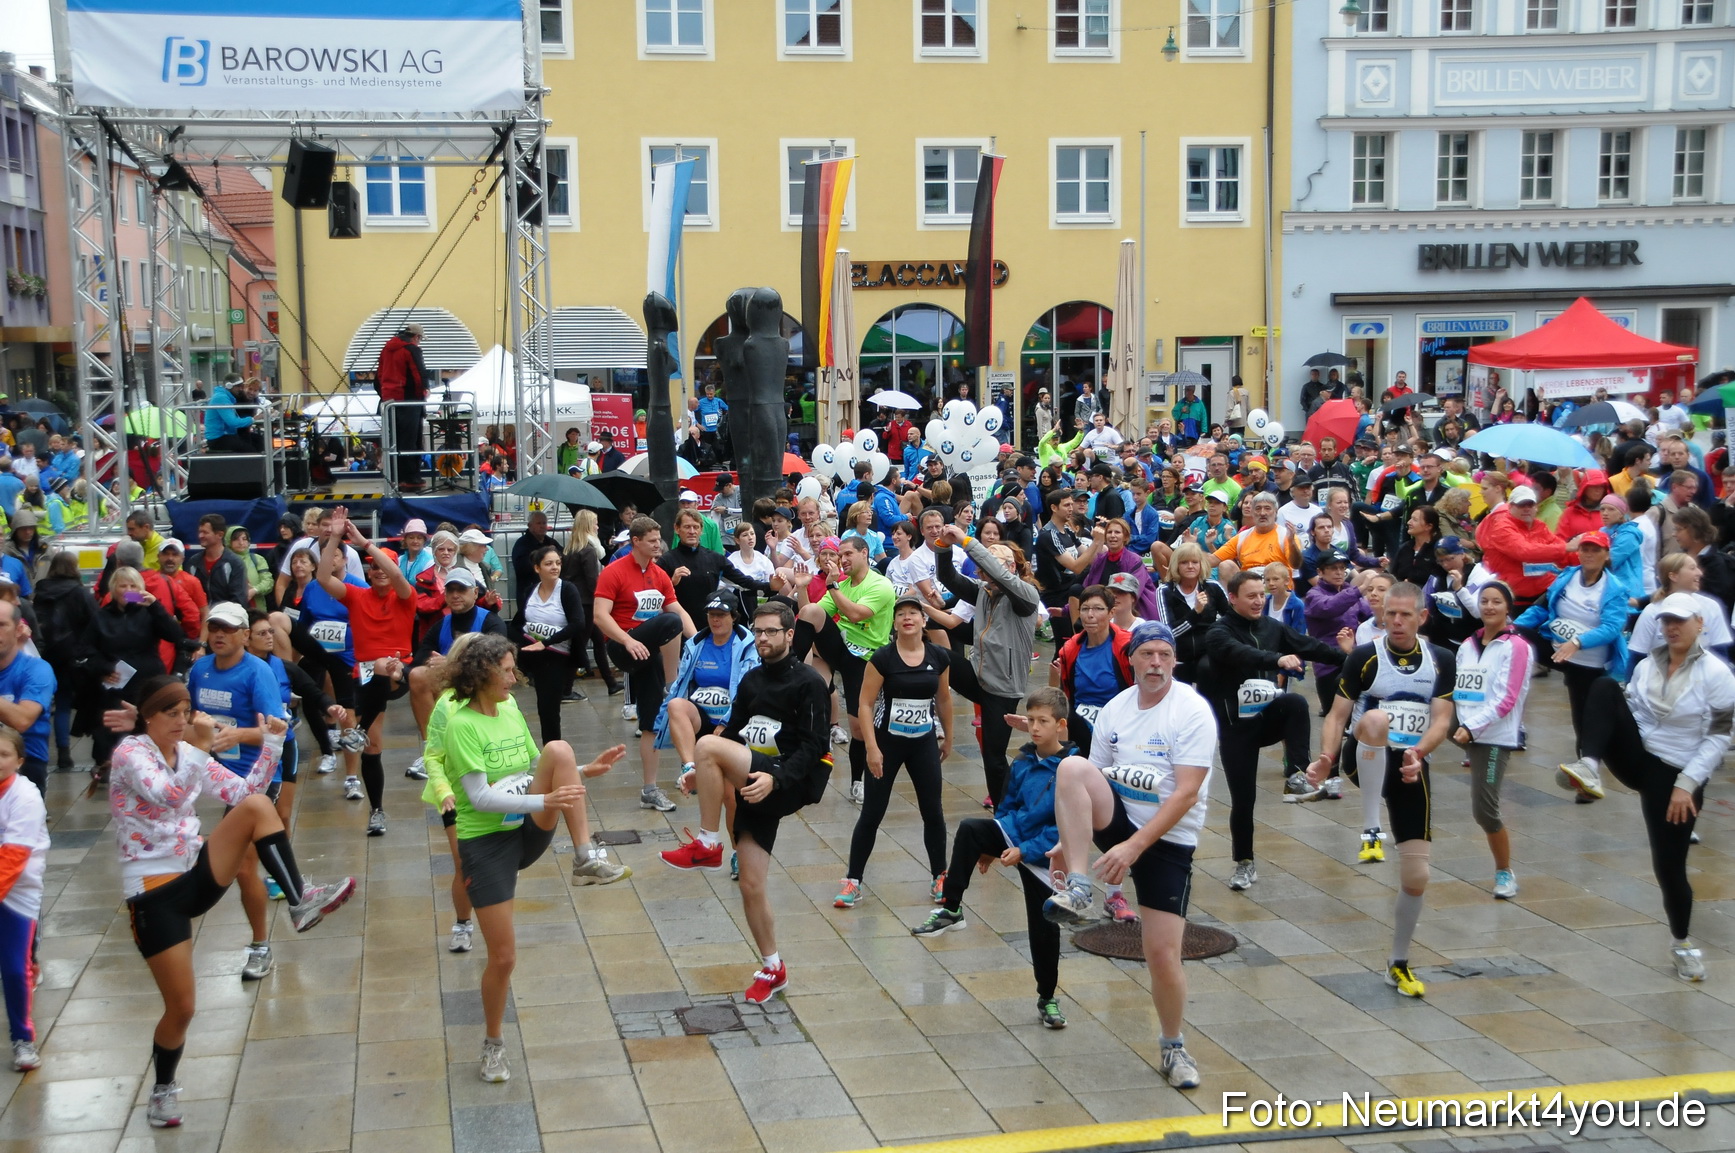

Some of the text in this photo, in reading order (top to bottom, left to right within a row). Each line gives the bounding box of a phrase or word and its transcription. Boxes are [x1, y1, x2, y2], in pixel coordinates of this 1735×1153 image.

[221, 46, 444, 74] BAROWSKI AG
[223, 75, 443, 89] Veranstaltungs- und Mediensysteme
[1446, 65, 1637, 93] BRILLEN WEBER
[1417, 238, 1644, 273] BRILLEN WEBER
[1426, 319, 1505, 332] BRILLEN WEBER
[1247, 346, 1260, 356] 24
[1566, 377, 1625, 387] LEBENSRETTER!
[641, 597, 663, 611] 2098
[314, 627, 342, 642] 3124
[529, 623, 556, 638] 5030
[695, 692, 729, 706] 2208
[895, 709, 928, 724] 2229
[1388, 712, 1426, 734] 2132
[1107, 766, 1155, 791] 3180
